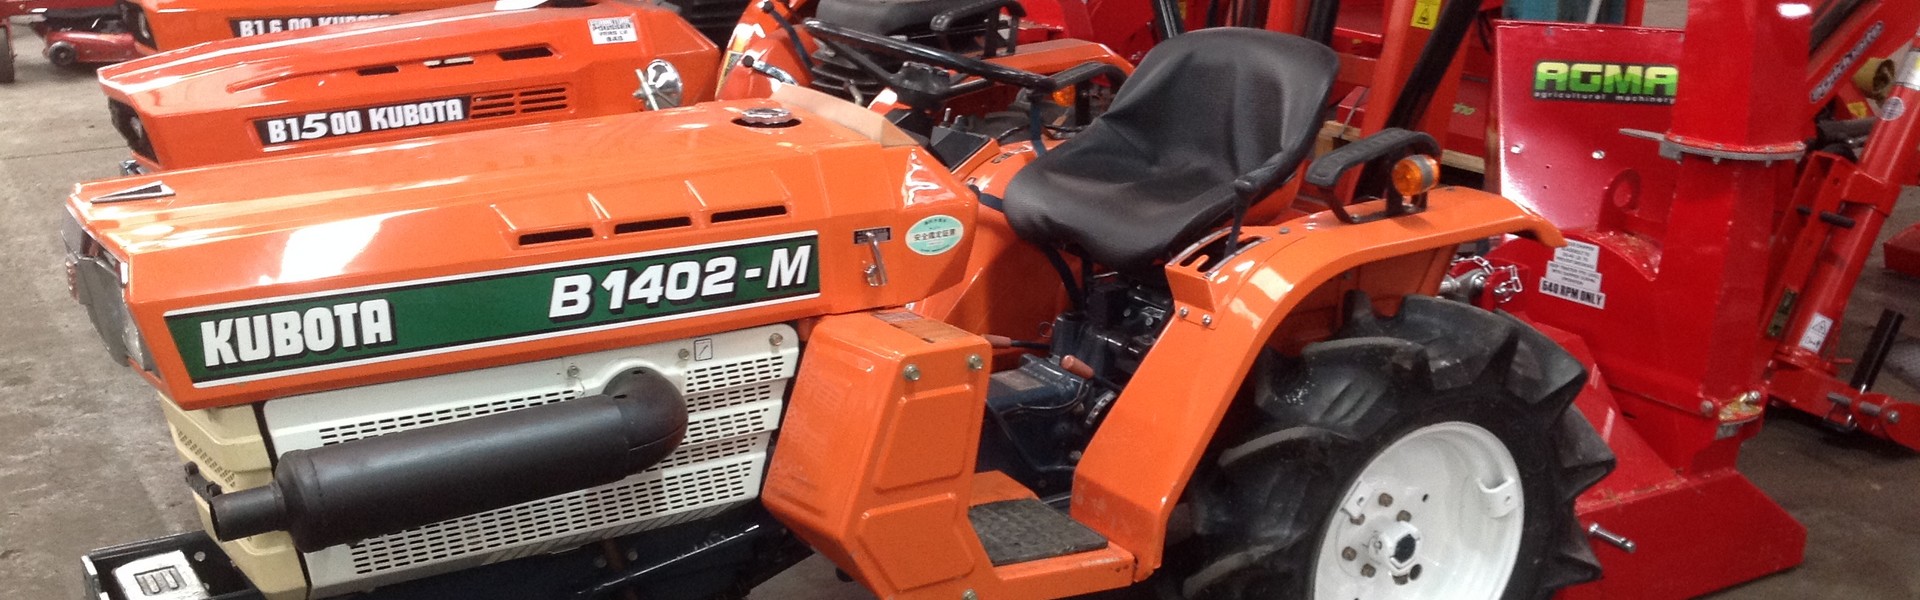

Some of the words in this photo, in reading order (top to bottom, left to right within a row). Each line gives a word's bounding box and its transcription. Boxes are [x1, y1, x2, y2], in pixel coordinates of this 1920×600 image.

[1535, 62, 1678, 96] AGMA
[1534, 92, 1606, 100] agricultural
[1615, 95, 1675, 104] machinery
[267, 113, 362, 144] B1500
[368, 99, 465, 131] KUBOTA
[1560, 285, 1579, 299] RPM
[1580, 290, 1602, 305] ONLY
[201, 299, 392, 367] KUBOTA
